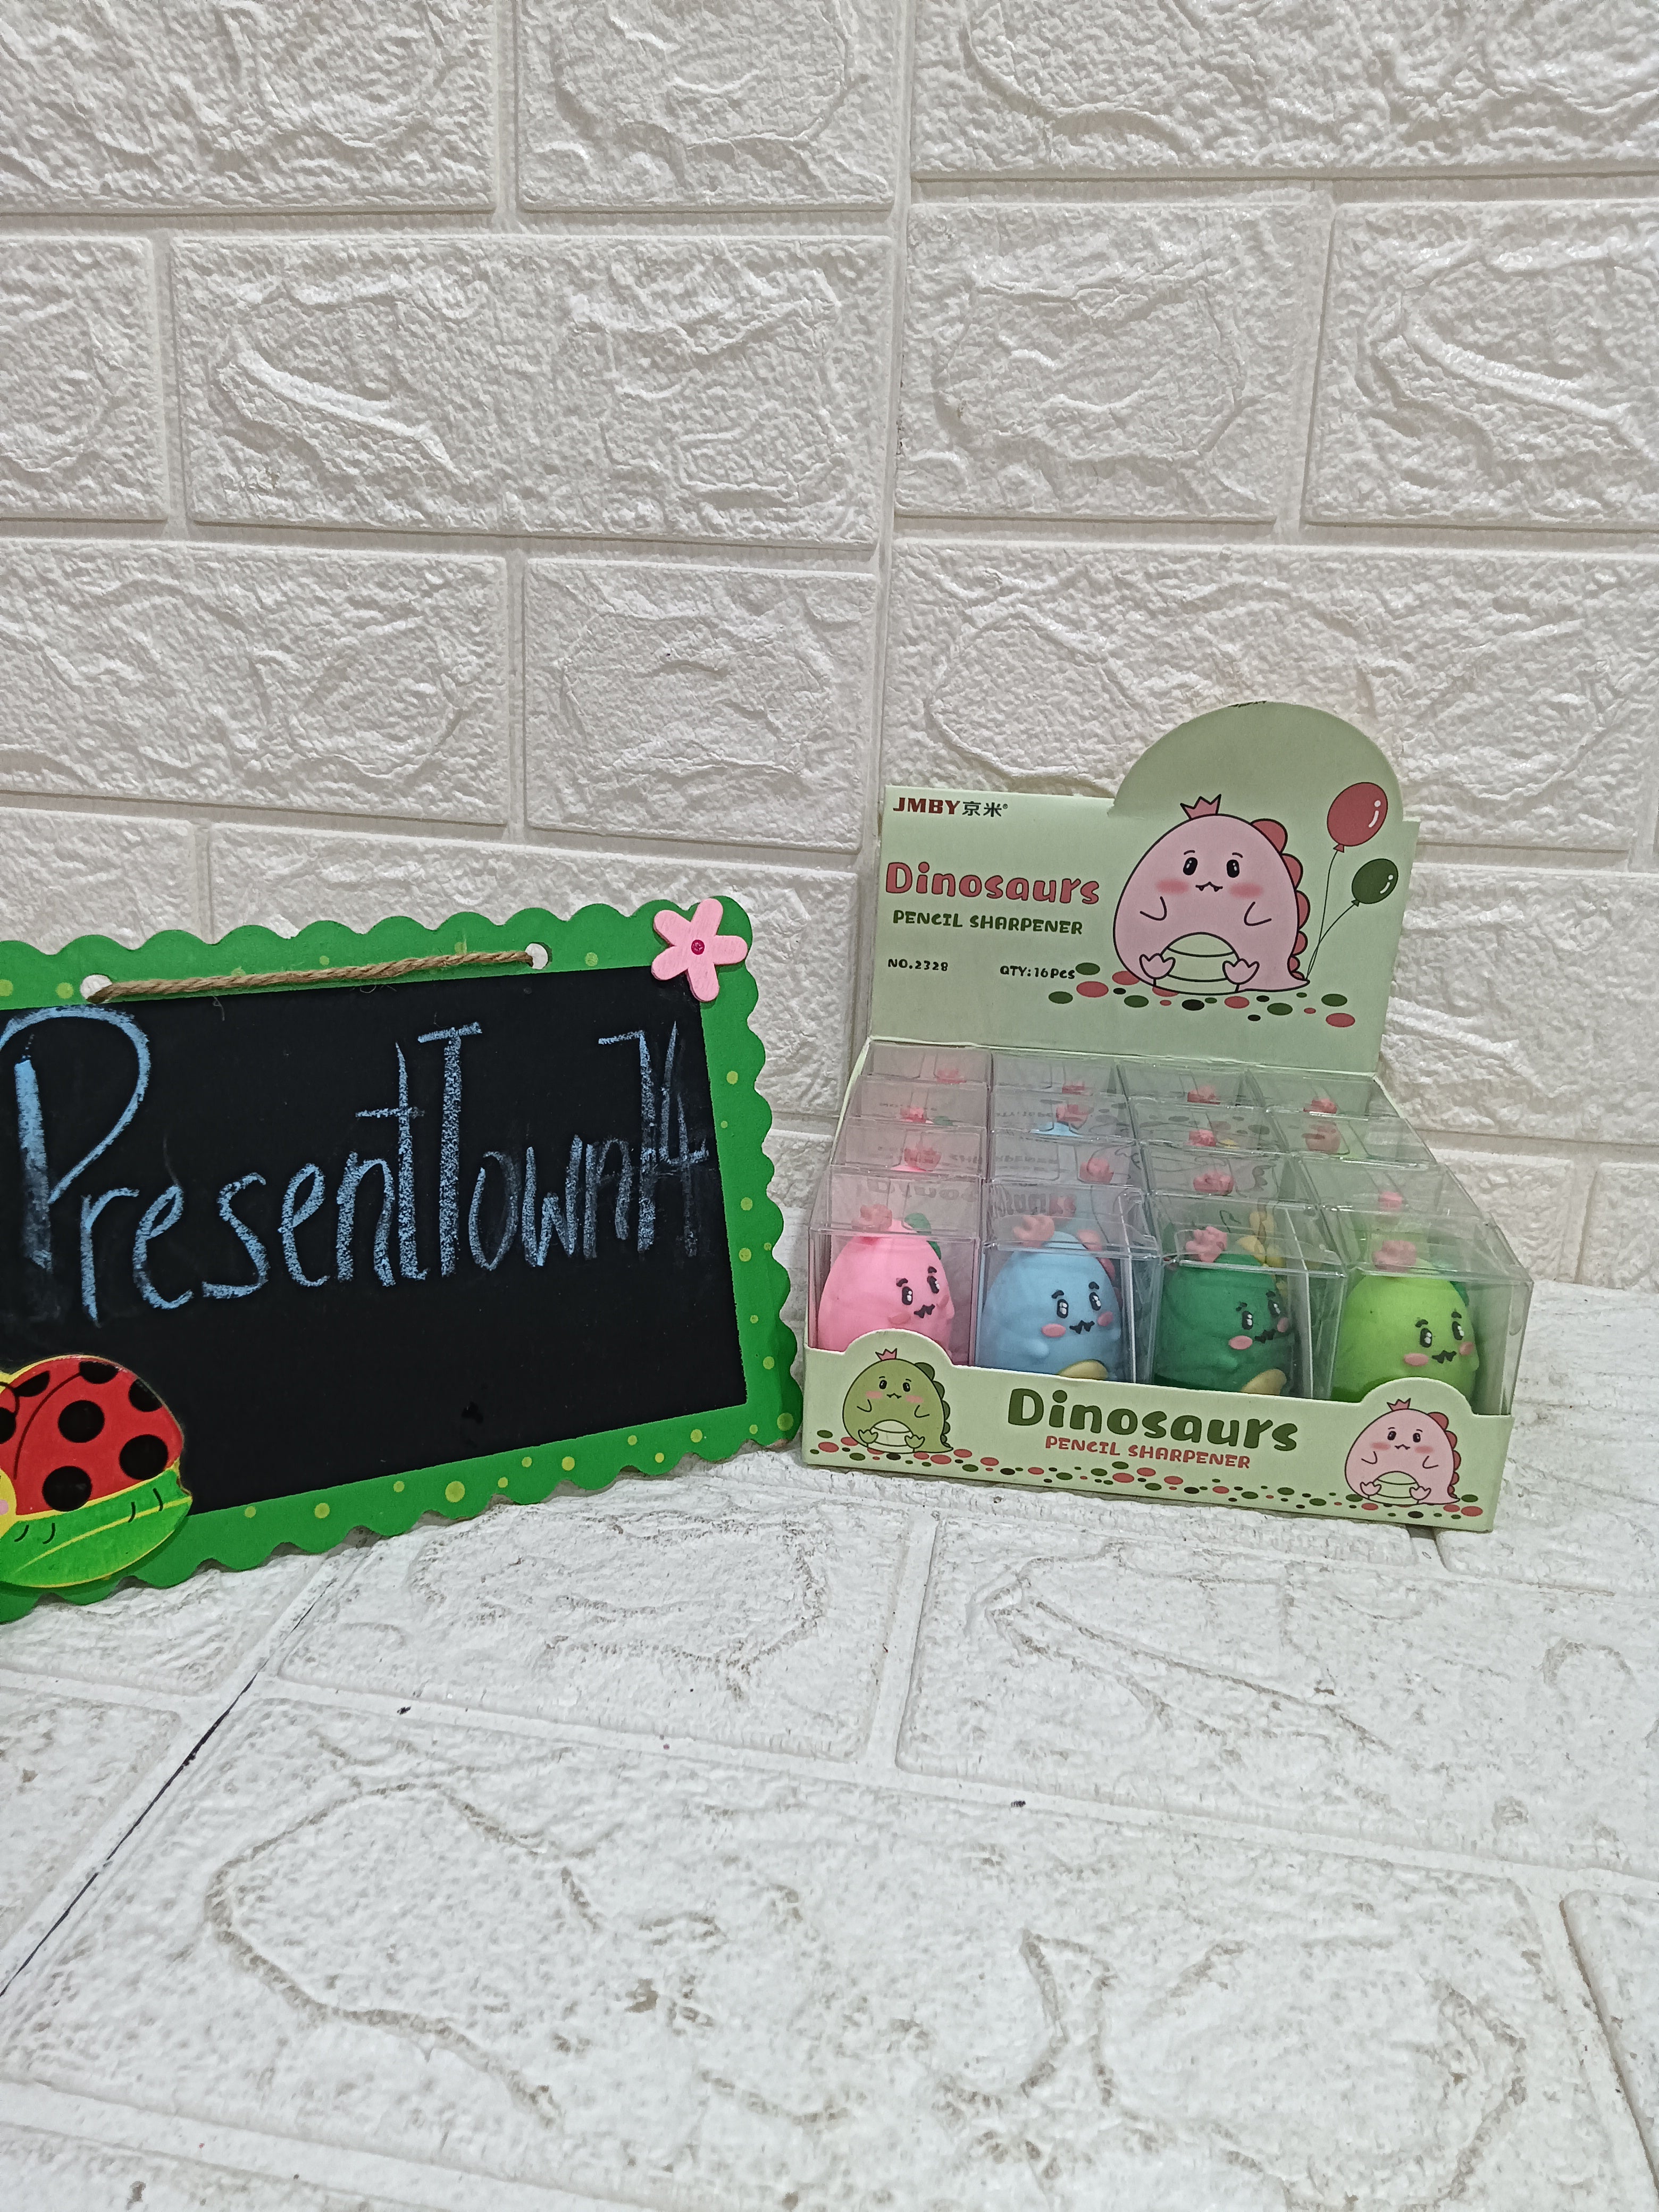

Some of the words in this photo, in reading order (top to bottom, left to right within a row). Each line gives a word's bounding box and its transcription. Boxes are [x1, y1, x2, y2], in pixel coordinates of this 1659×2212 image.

[893, 797, 960, 815] JMBY
[885, 861, 1100, 904] Dinosaurs
[893, 910, 963, 927] PENCIL
[969, 915, 1083, 935] SHARPENER
[887, 959, 949, 972] NO.2328
[1008, 1388, 1298, 1452] Dinosaurs
[1045, 1435, 1120, 1456] PENCIL
[1128, 1445, 1250, 1469] SHARPENER
